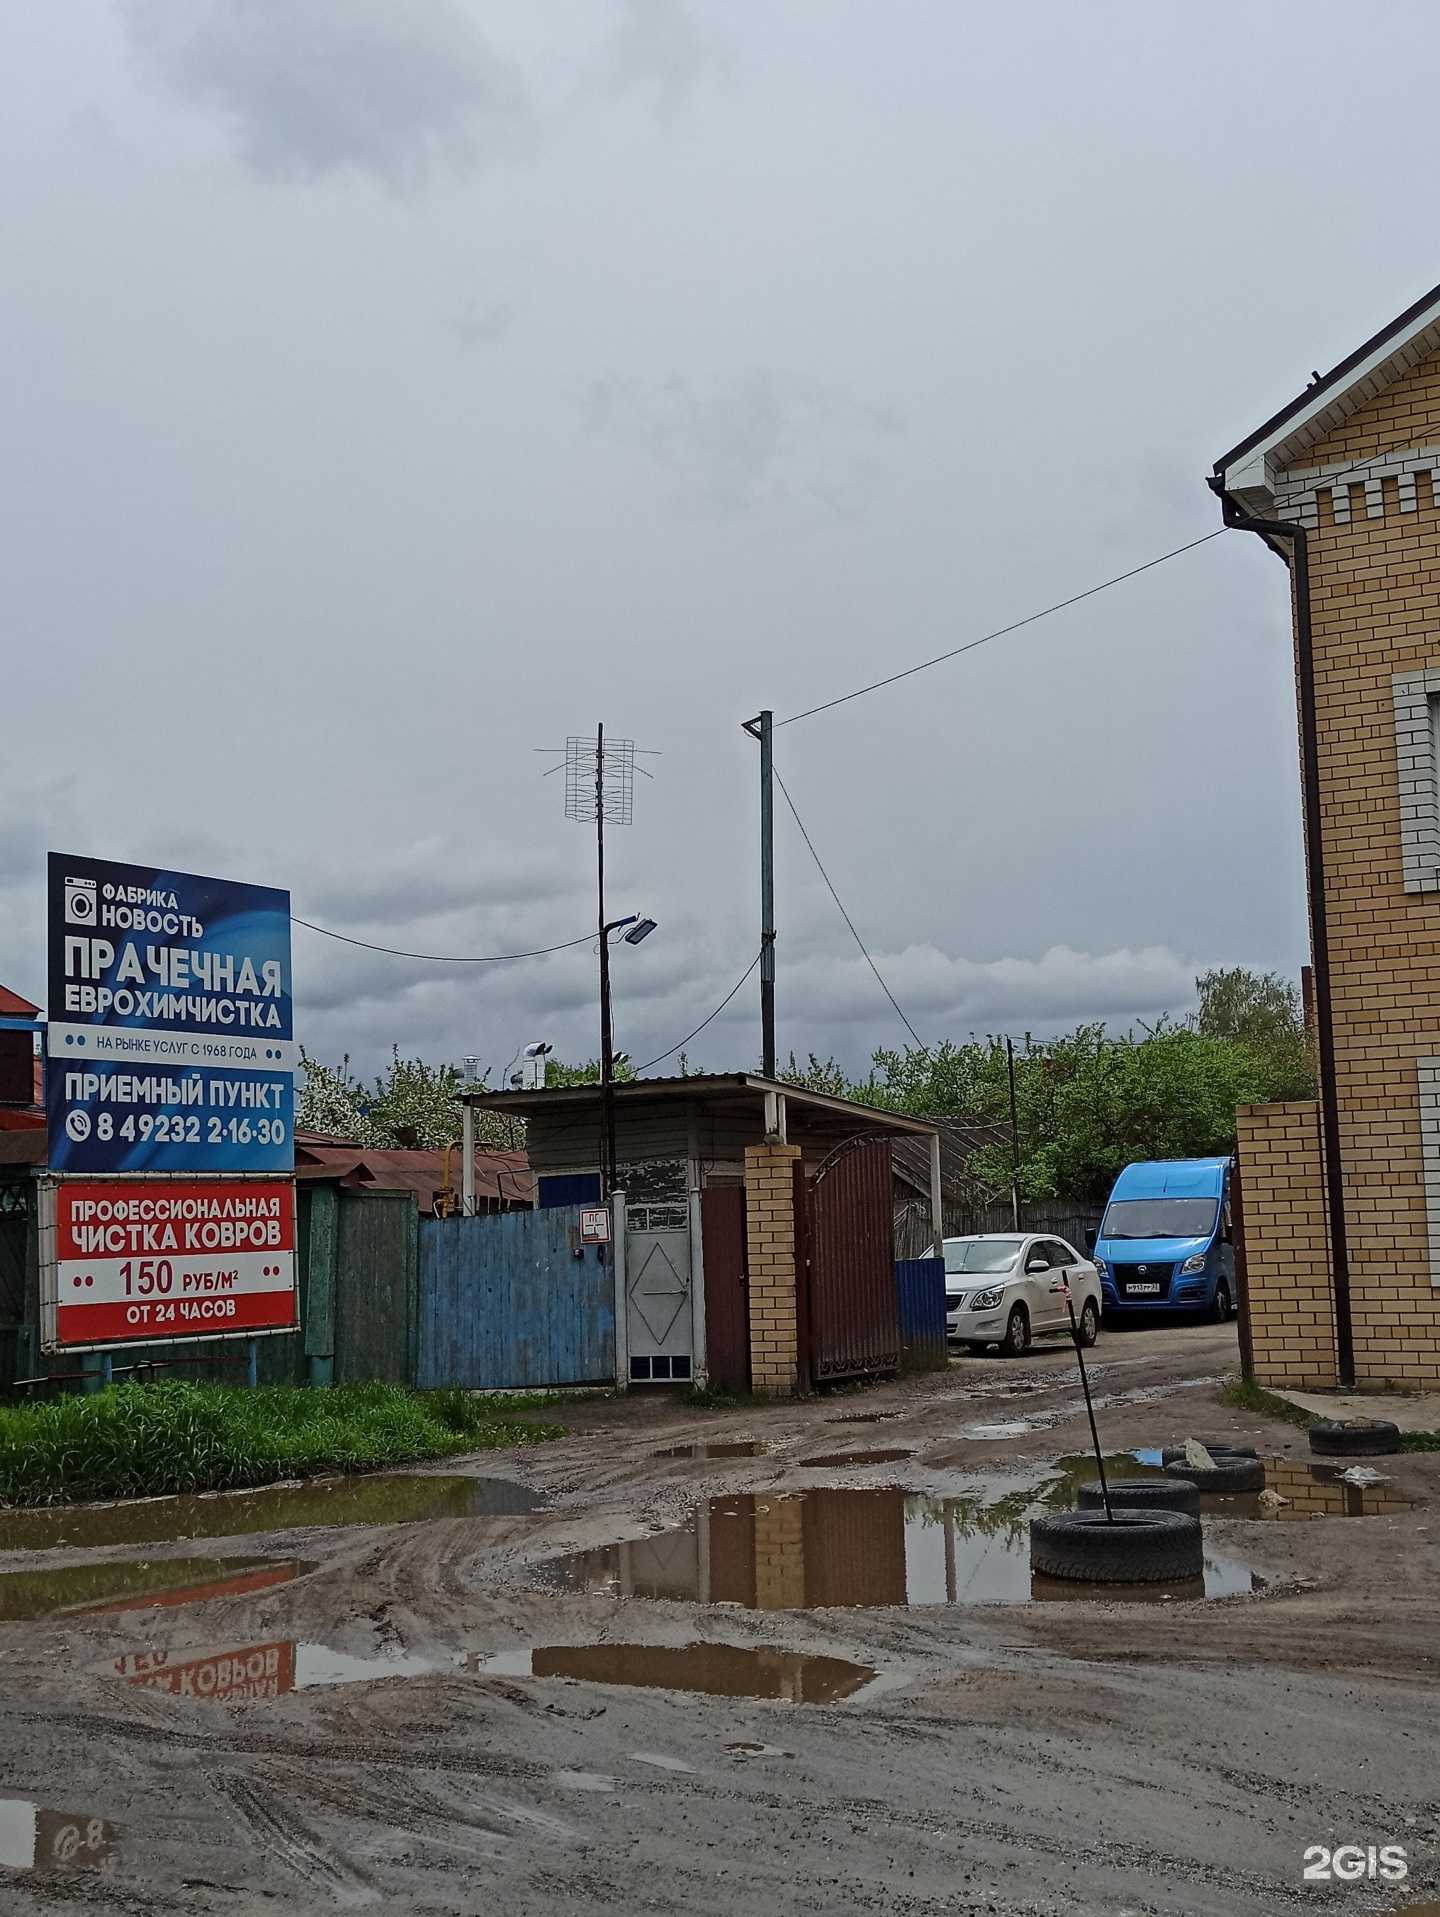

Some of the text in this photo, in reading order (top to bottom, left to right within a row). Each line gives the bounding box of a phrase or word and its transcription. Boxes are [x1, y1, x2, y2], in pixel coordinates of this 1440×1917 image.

[102, 883, 179, 909] ФАБРИКА
[102, 905, 204, 938] НОВОСТЬ
[64, 935, 281, 997] ПРАЧЕЧНАЯ
[64, 984, 282, 1028] ЕВРОХИМЧИСТКА
[97, 1036, 257, 1060] НА РЫНКЕ УСЛУГ С 1968 ГОДА
[65, 1072, 285, 1109] ПРИЕМНЫЙ ПУНКТ
[97, 1112, 114, 1142] 8
[119, 1113, 201, 1143] 49232
[71, 1197, 281, 1222] ПРОФЕССИОНАЛЬНАЯ
[71, 1220, 281, 1253] ЧИСТКА КОВРОВ
[119, 1260, 173, 1295] 150
[127, 1300, 236, 1324] ОТ 24 ЧАСОВ
